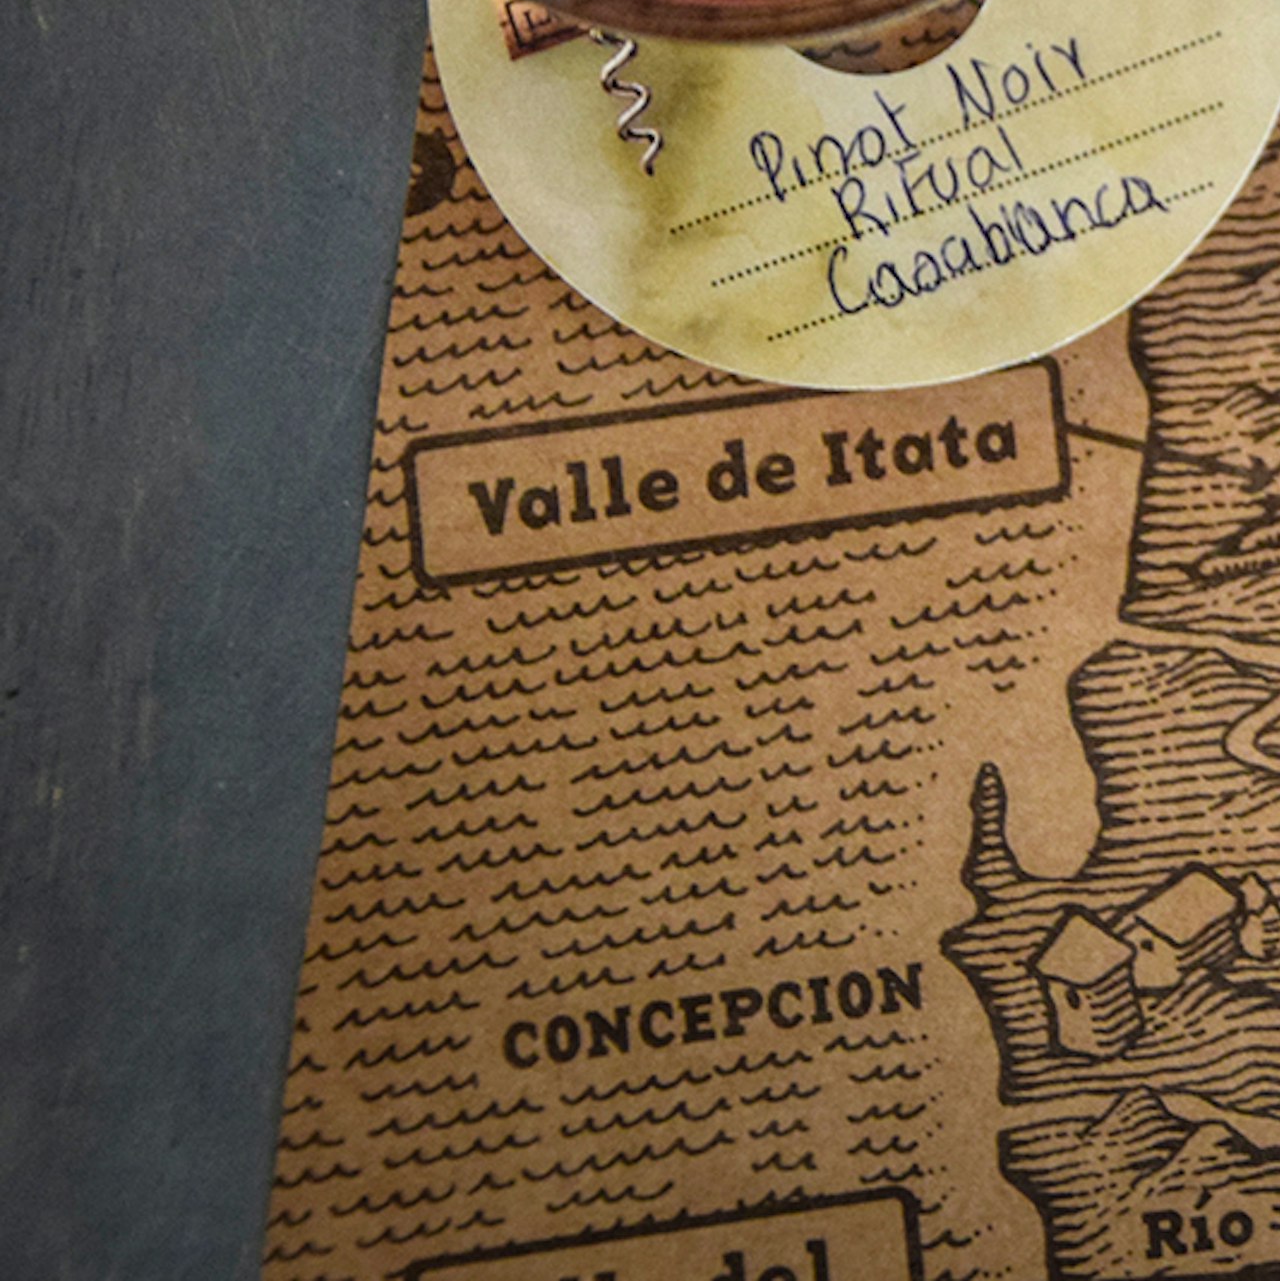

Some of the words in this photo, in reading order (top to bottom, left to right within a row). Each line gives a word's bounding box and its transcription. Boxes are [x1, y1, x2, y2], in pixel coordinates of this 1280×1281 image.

[749, 90, 917, 201] Pinot
[946, 36, 1086, 127] Noir
[831, 125, 1023, 238] Ritual
[827, 174, 1168, 314] Casablanca
[468, 455, 680, 535] Valle
[705, 440, 797, 501] de
[822, 416, 1019, 487] Itata
[504, 963, 924, 1070] CONCEPCION
